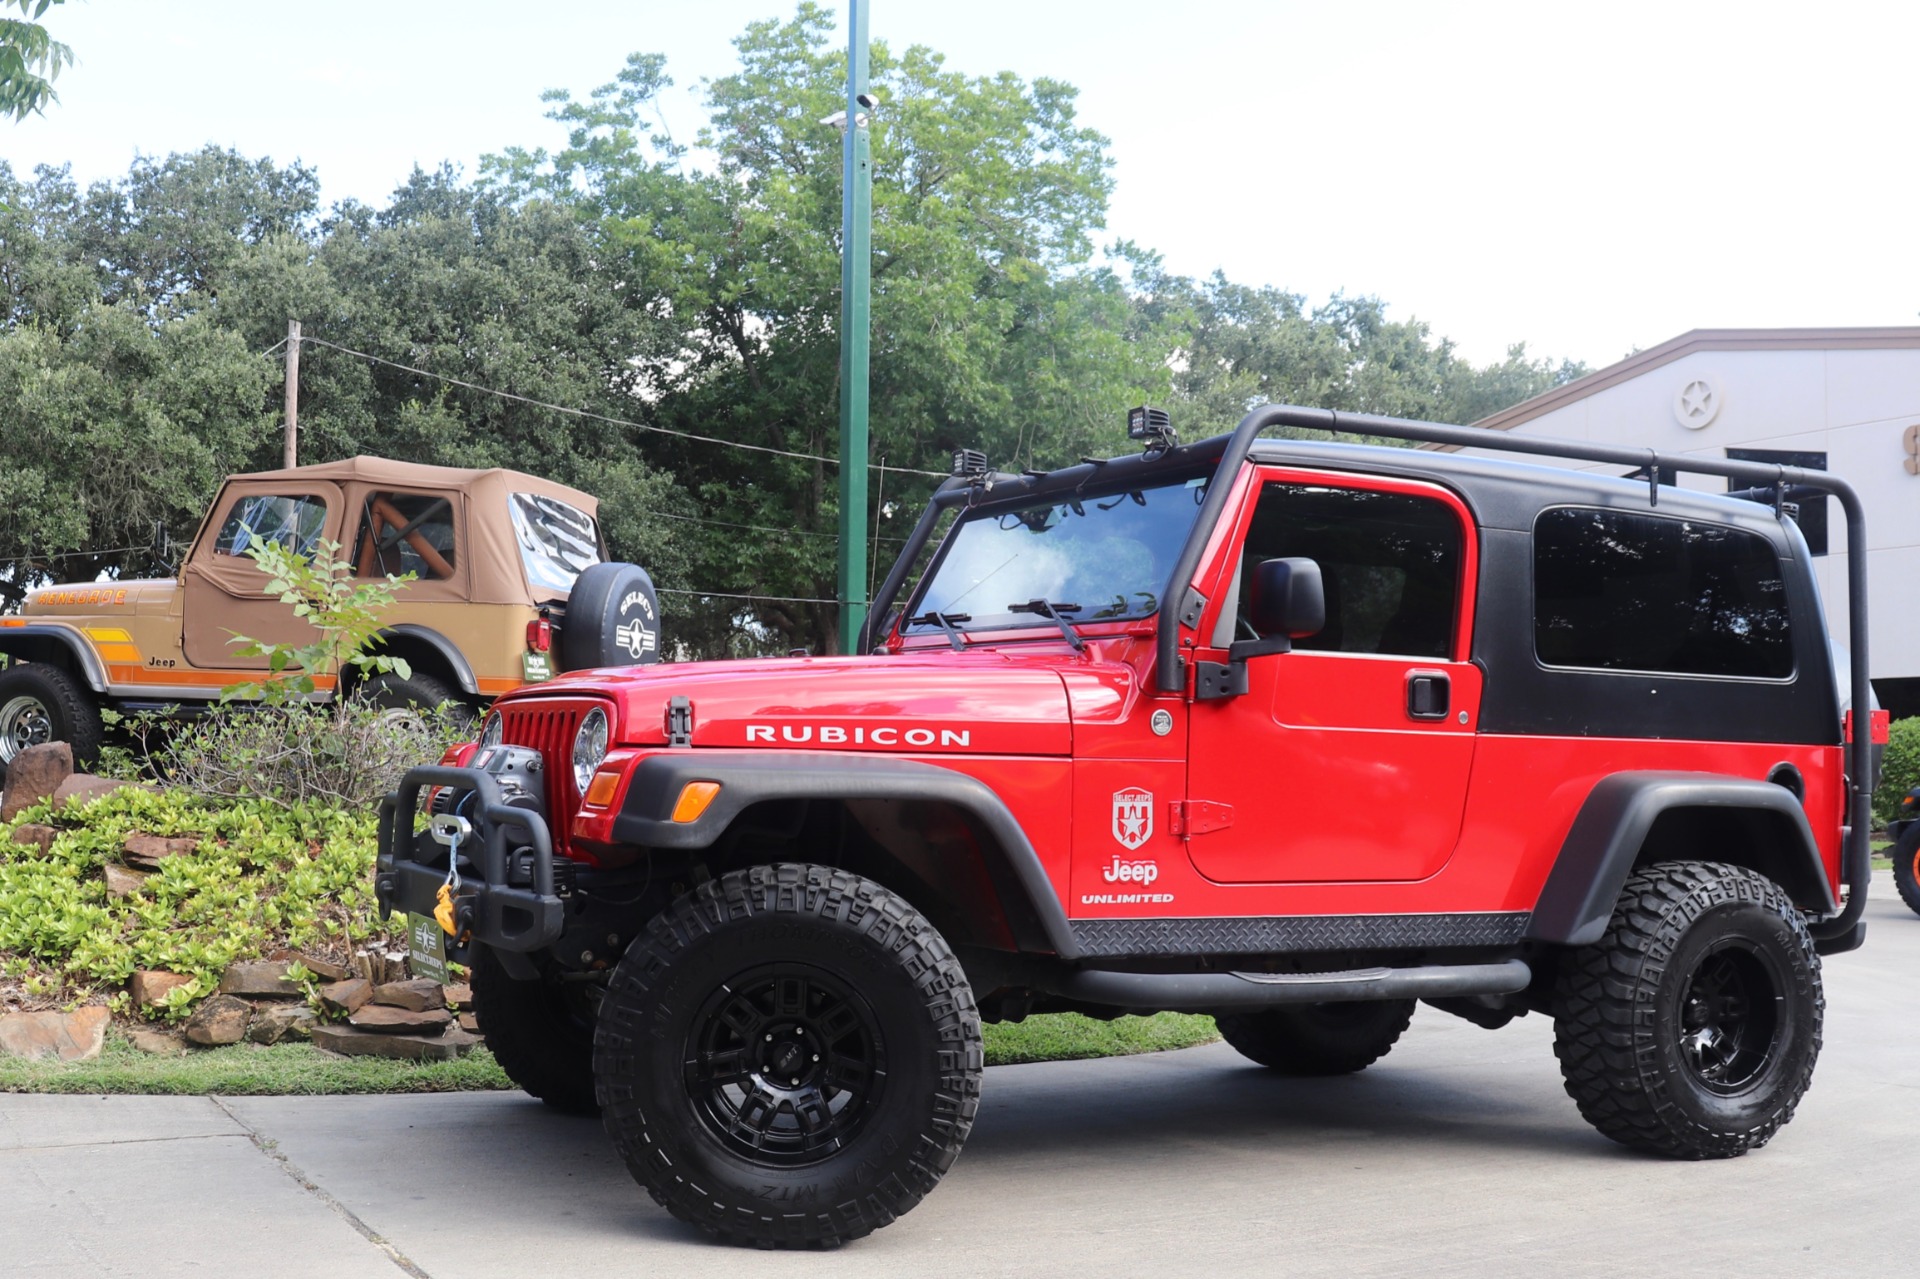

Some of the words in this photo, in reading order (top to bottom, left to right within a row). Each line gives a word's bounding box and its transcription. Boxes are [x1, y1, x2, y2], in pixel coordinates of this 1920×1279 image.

[38, 589, 127, 606] RENEGADE
[620, 591, 654, 621] SELECT
[149, 656, 176, 668] Jeep
[746, 725, 970, 746] RUBICON
[1103, 856, 1158, 886] Jeep
[1081, 894, 1174, 904] UNLIMITED
